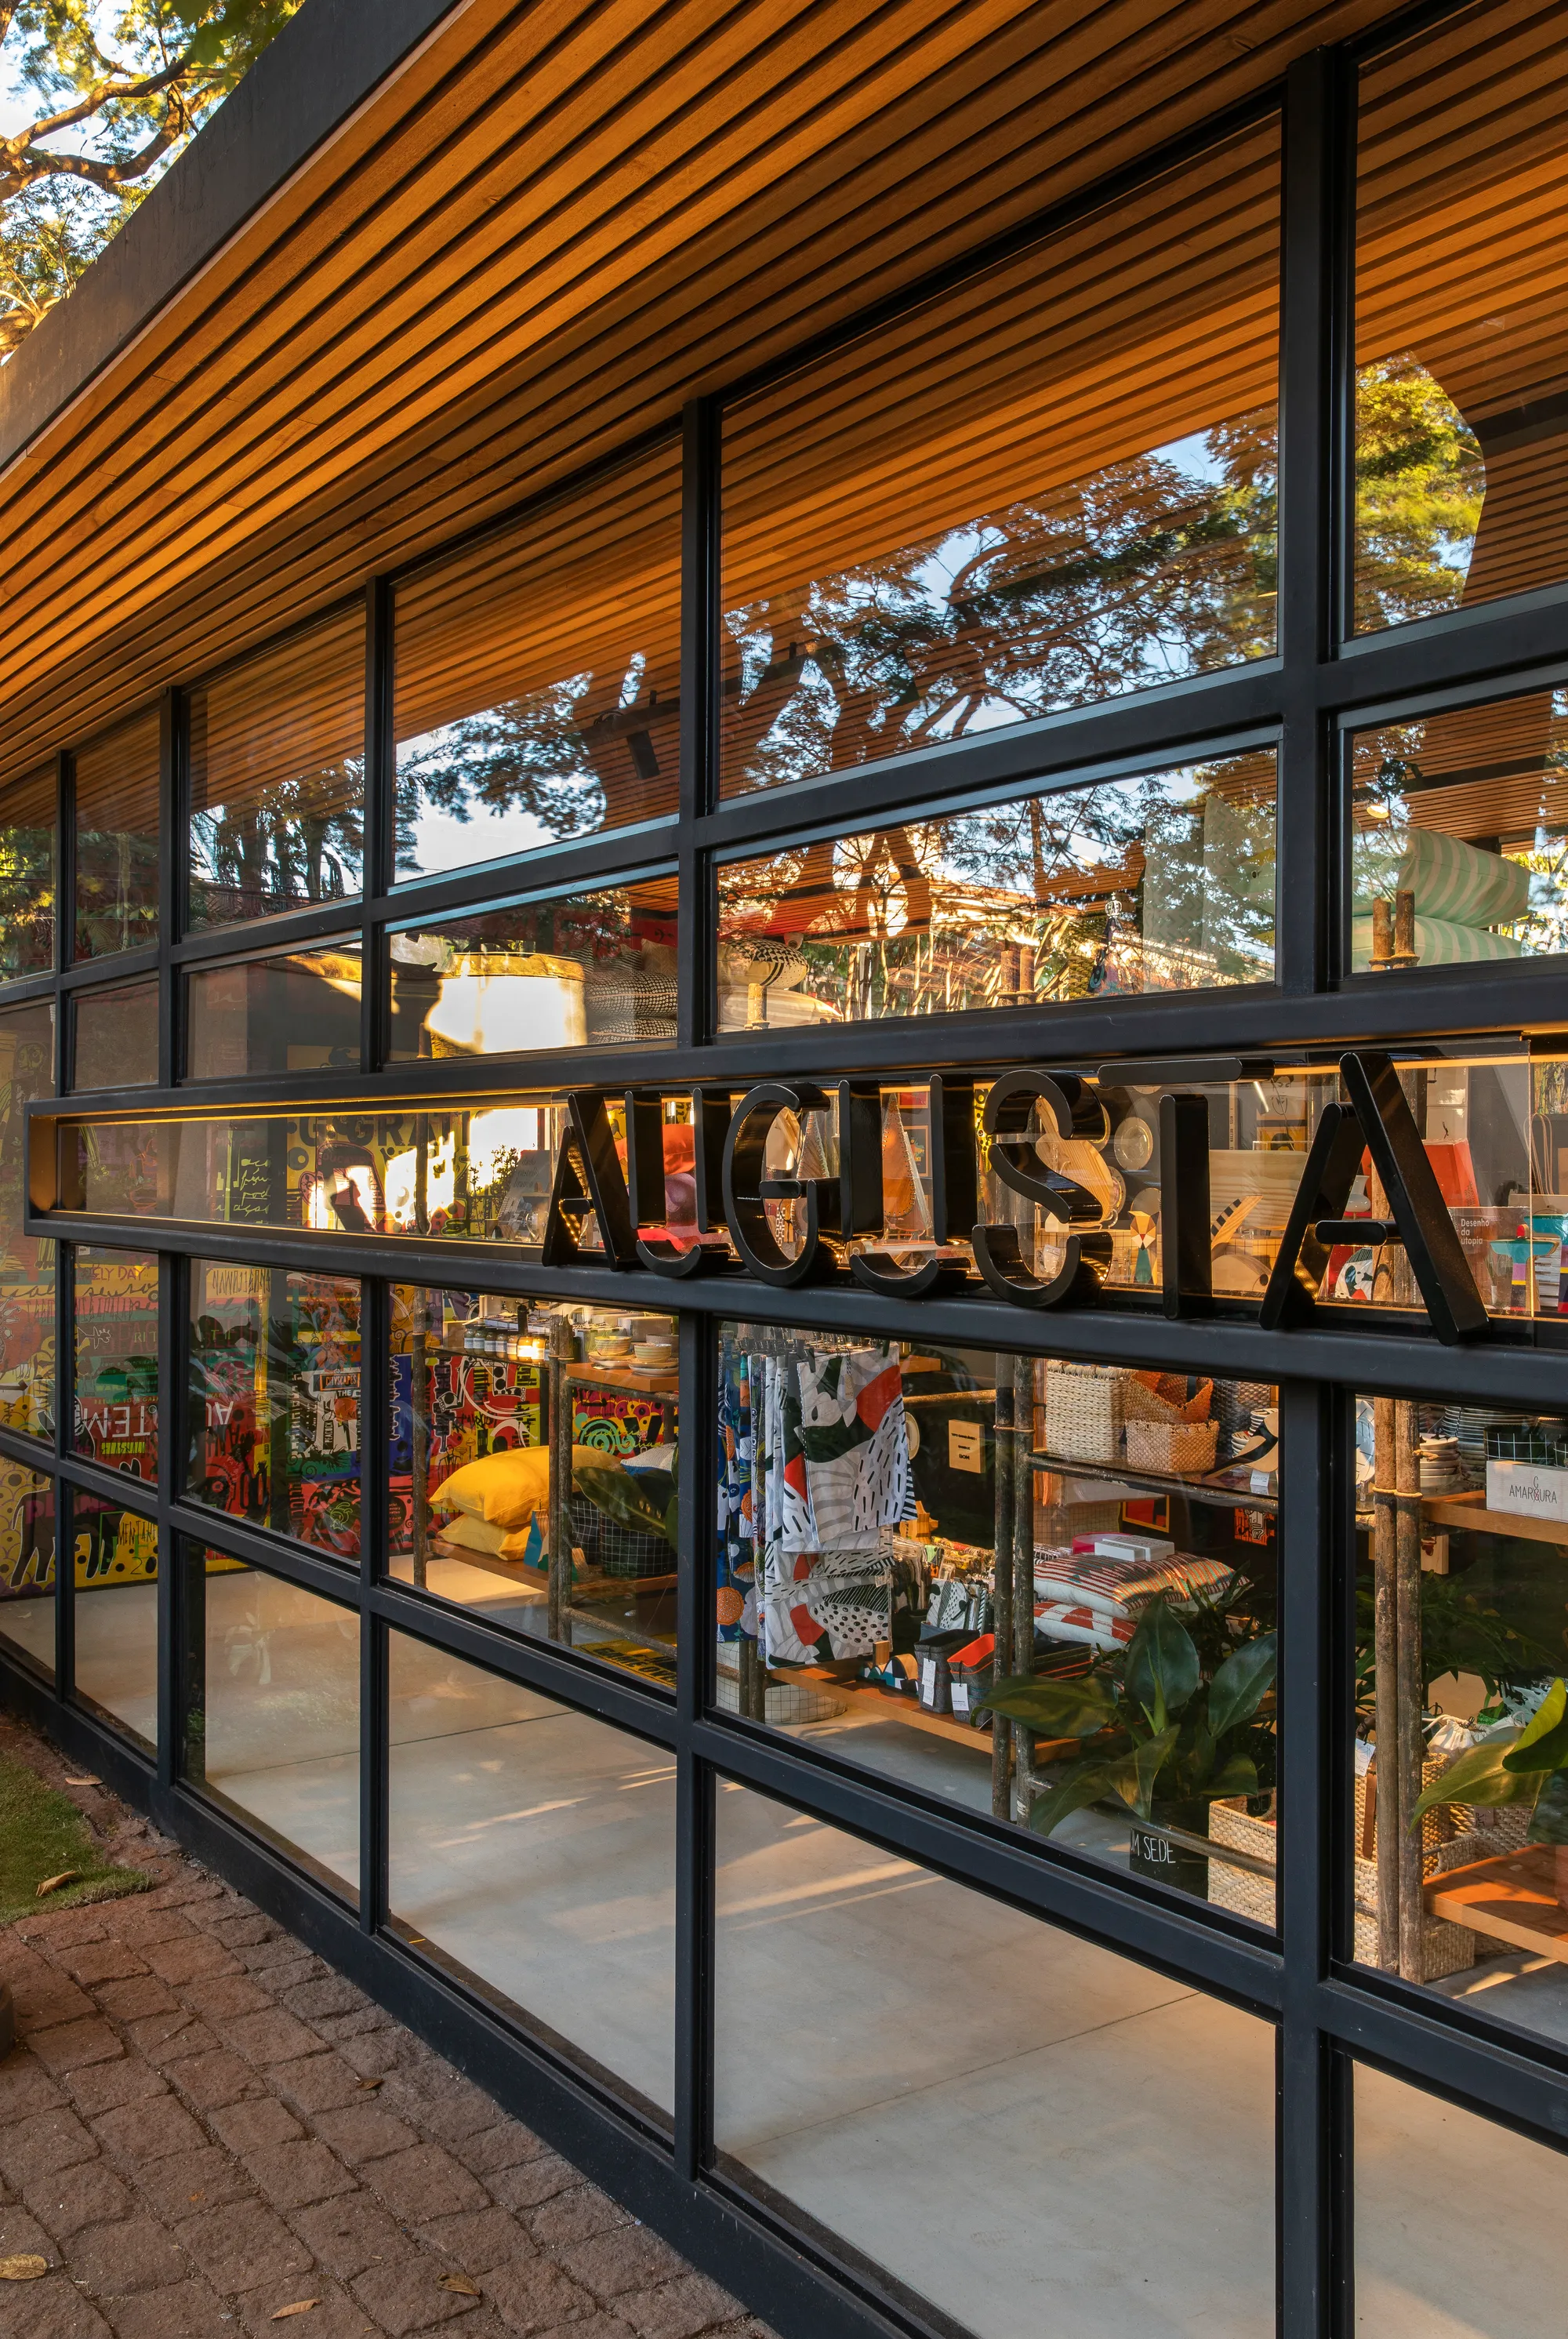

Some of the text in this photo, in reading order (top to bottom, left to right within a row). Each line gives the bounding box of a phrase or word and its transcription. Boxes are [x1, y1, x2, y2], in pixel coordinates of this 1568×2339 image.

[543, 1052, 1490, 1346] AUGUSTA
[1461, 1218, 1490, 1227] Desenho
[1461, 1237, 1483, 1246] utopia
[118, 1266, 147, 1281] DAY
[325, 1375, 357, 1386] CITYSCAPES
[1144, 1836, 1176, 1863] SEDE
